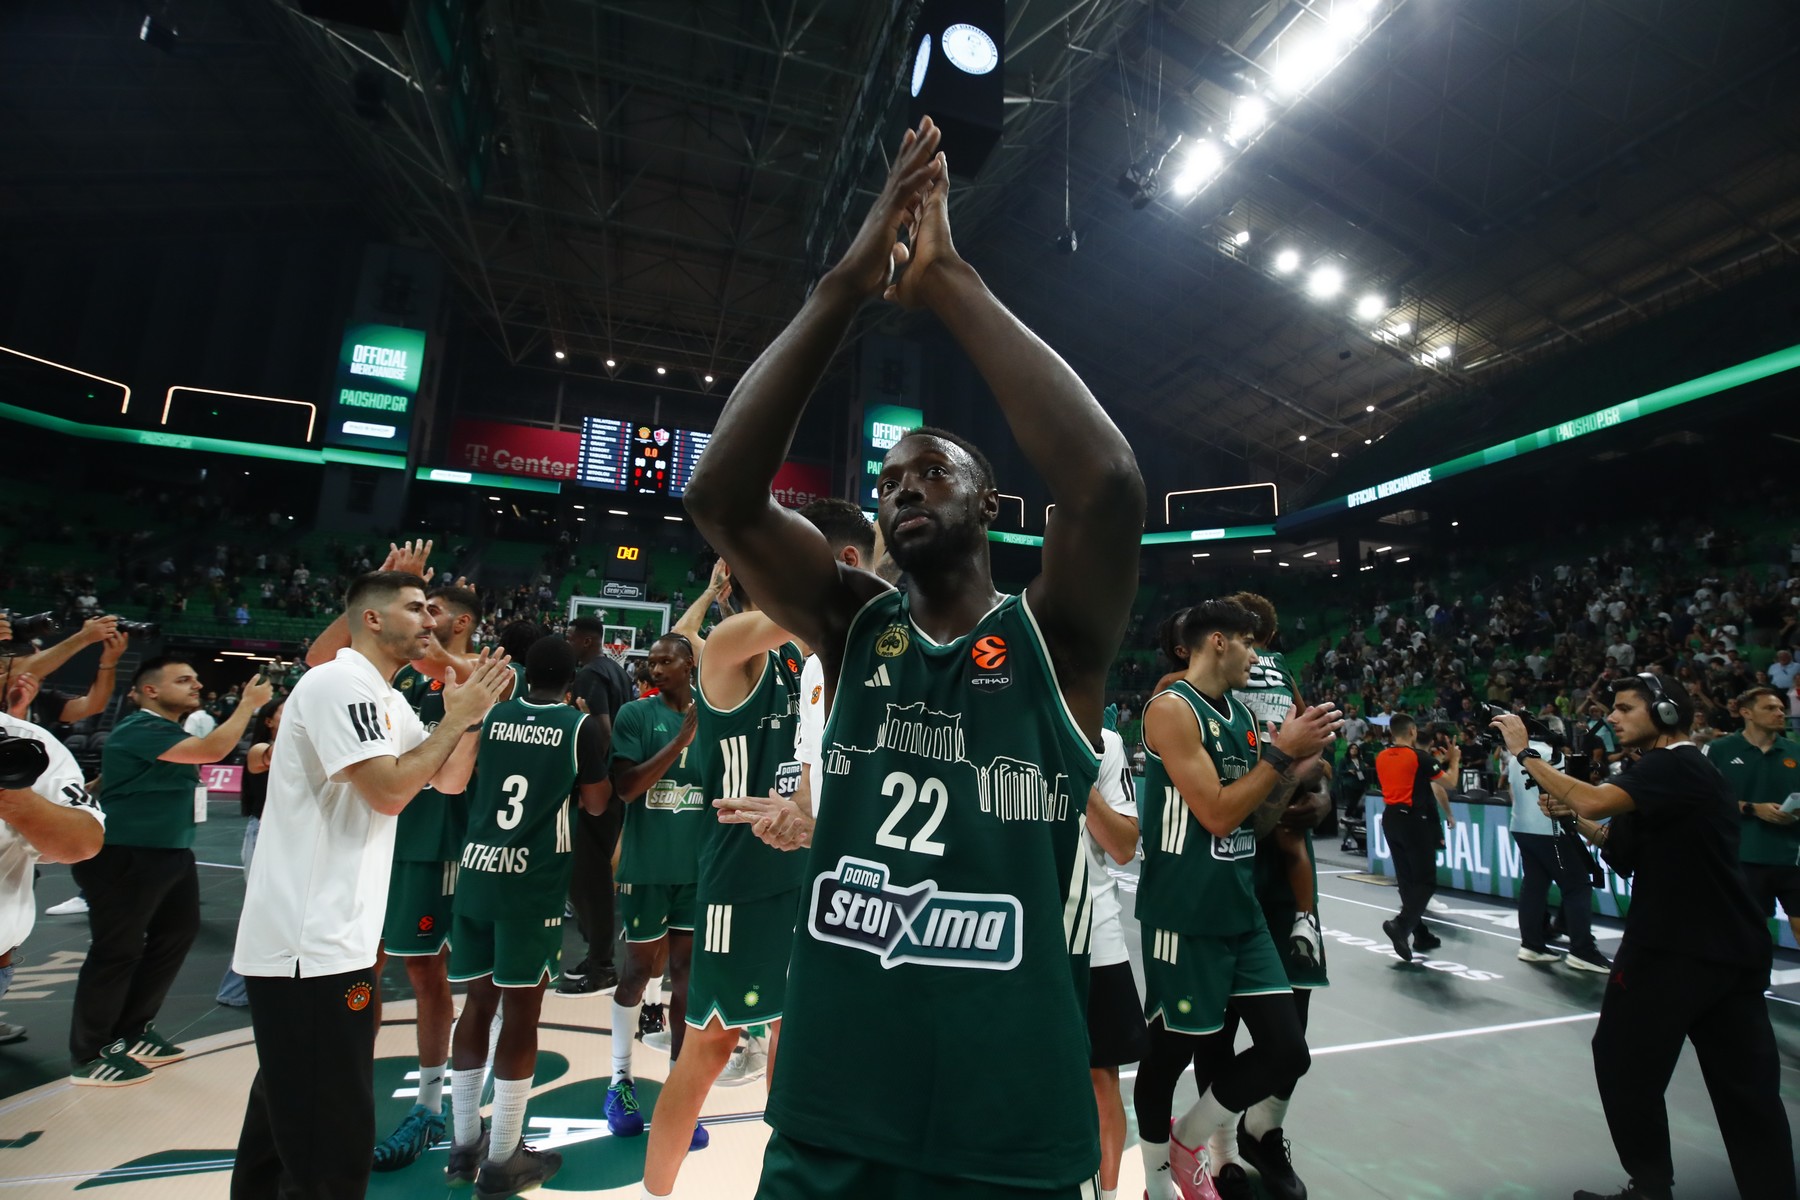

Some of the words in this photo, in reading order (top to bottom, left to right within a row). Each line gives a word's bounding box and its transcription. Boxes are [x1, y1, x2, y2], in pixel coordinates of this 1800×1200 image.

[353, 344, 408, 368] OFFICIAL
[350, 362, 406, 380] MERCHANDISE
[339, 389, 408, 412] PAOSHOP.GR
[1555, 407, 1620, 441] PAOSHOP.GR
[493, 449, 575, 477] Center
[644, 447, 658, 458] 0.0
[774, 487, 816, 505] nter
[1347, 486, 1378, 508] OFFICIAL
[1376, 468, 1432, 500] MERCHANDISE
[971, 677, 1009, 685] ETIHAD
[489, 722, 563, 747] FRANCISCO
[496, 774, 528, 830] 3
[875, 771, 950, 857] 22
[460, 842, 529, 874] ATHENS
[843, 865, 881, 890] pame
